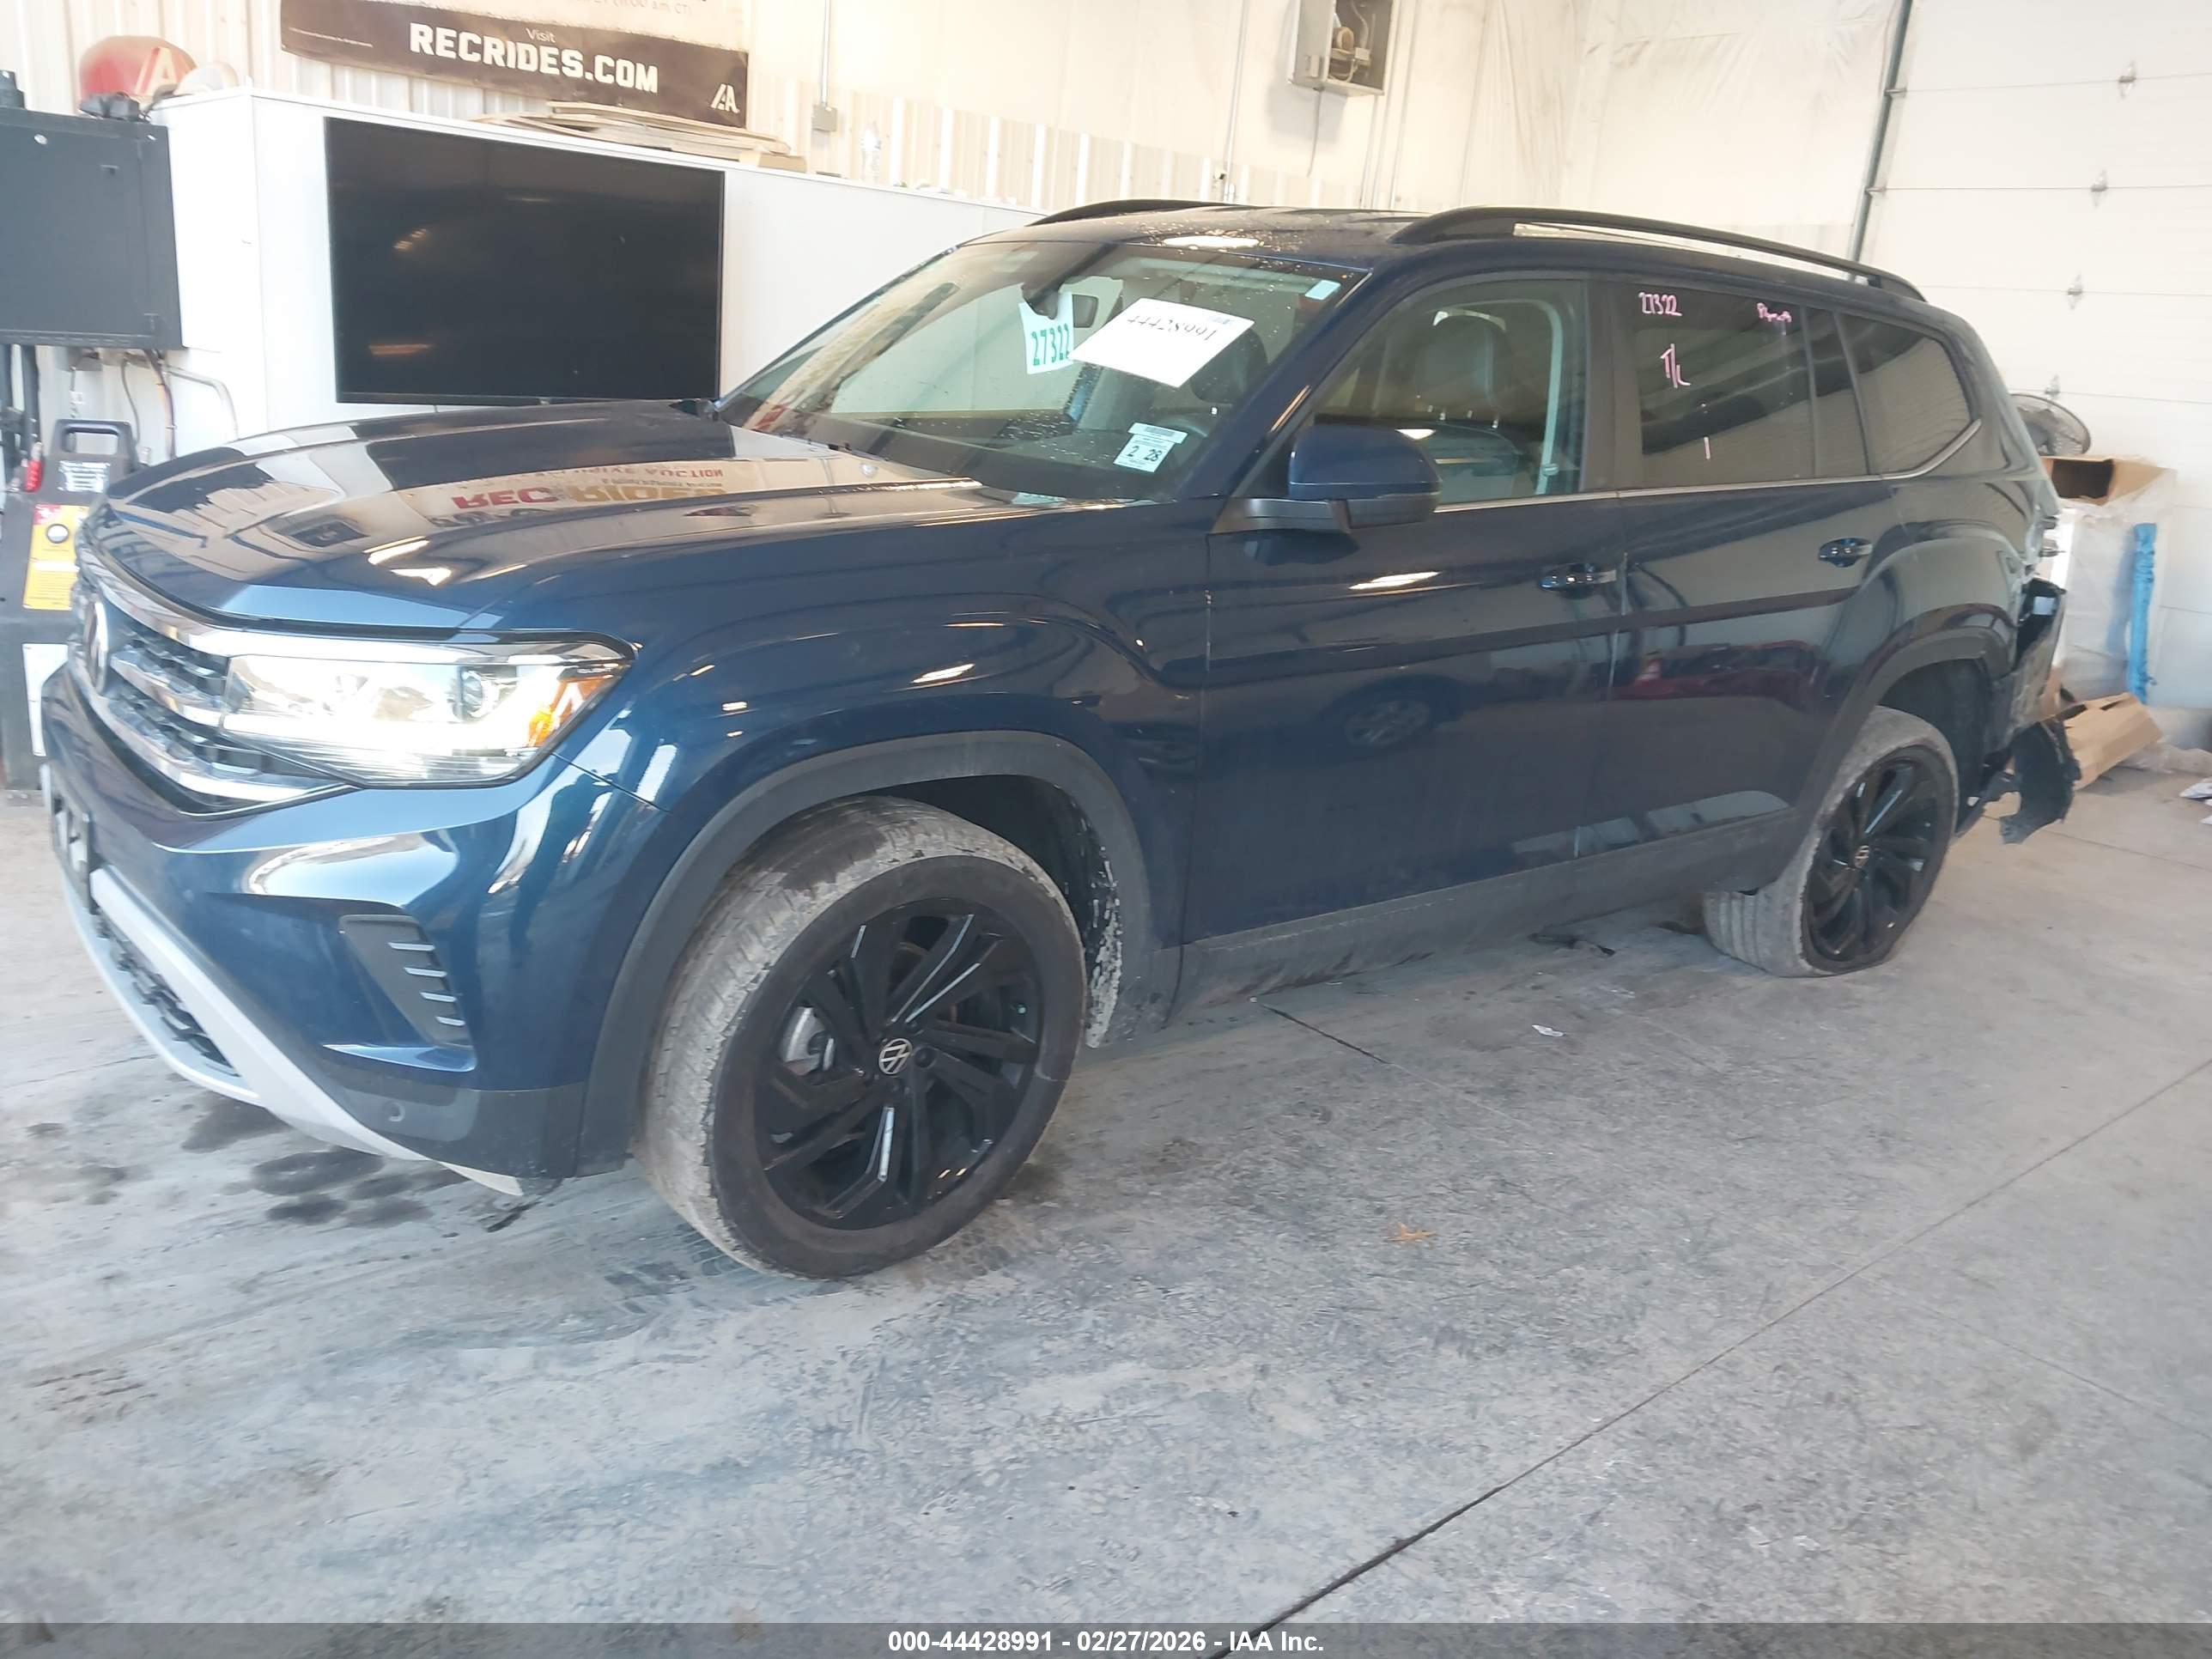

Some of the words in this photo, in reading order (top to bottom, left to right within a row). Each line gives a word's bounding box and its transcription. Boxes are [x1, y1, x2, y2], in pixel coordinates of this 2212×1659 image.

[526, 27, 556, 45] Visit
[410, 22, 659, 94] RECRIDES.COM
[1638, 291, 1683, 317] 27322
[1126, 445, 1139, 457] 2
[1143, 447, 1163, 462] 28
